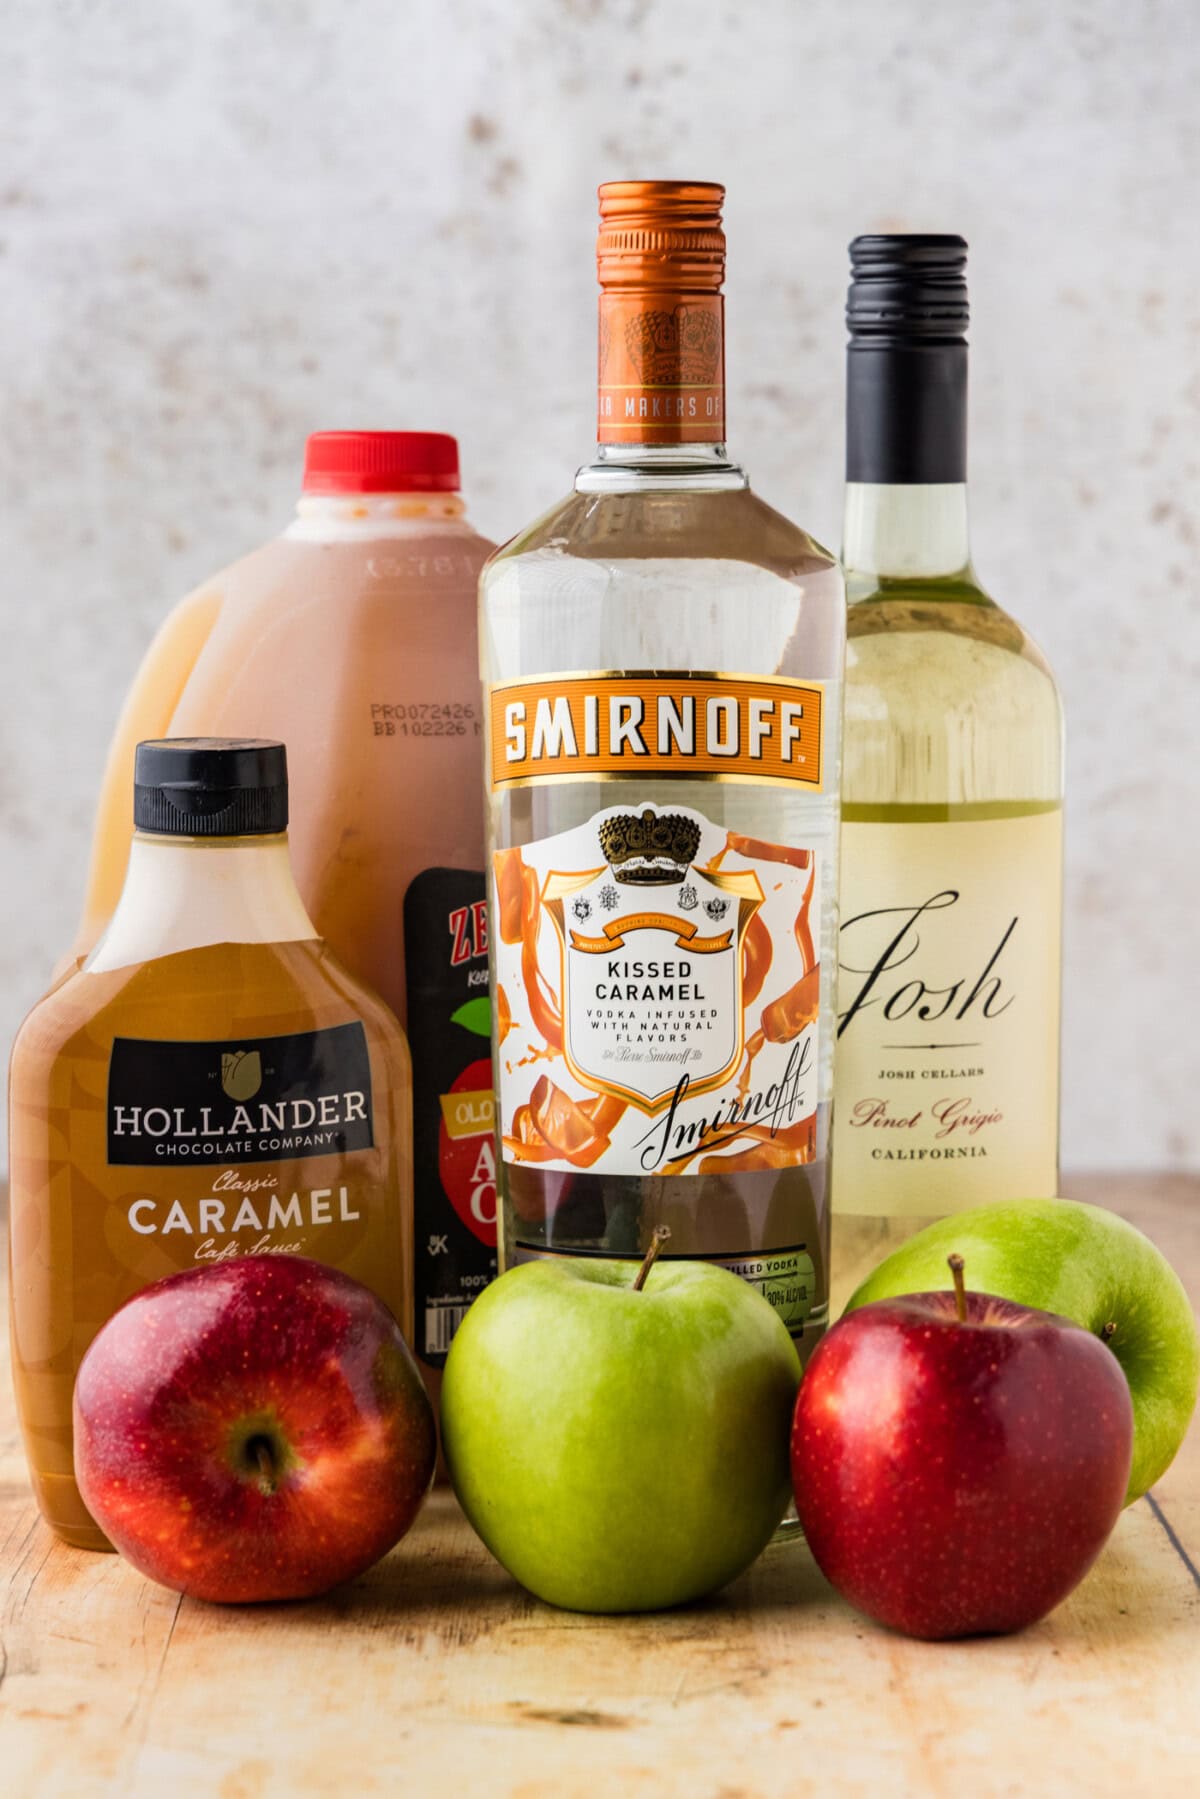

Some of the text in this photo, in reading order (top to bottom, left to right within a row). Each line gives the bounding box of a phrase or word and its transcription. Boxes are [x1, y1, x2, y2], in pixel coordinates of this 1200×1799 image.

[625, 397, 697, 416] MAKERS
[706, 396, 720, 416] OF
[505, 696, 803, 763] SMIRNOFF
[608, 962, 692, 978] KISSED
[837, 890, 1019, 1040] Josh
[595, 984, 705, 1001] CARAMEL
[587, 1009, 718, 1019] VODKA INFUSED
[591, 1021, 713, 1030] WITH NATURAL
[616, 1034, 688, 1042] FLAVORS
[878, 1067, 985, 1080] JOSH CELLARS
[113, 1091, 368, 1137] HOLLANDER
[632, 1037, 812, 1171] Smirnoff
[849, 1097, 1004, 1139] Pinot Grigio
[155, 1131, 334, 1156] CHOCOLATE COMPANY
[872, 1146, 988, 1160] CALIFORNIA
[212, 1169, 278, 1192] Classic
[128, 1187, 360, 1235] CARAMEL
[194, 1237, 239, 1262] Café
[766, 1259, 798, 1273] VODKA
